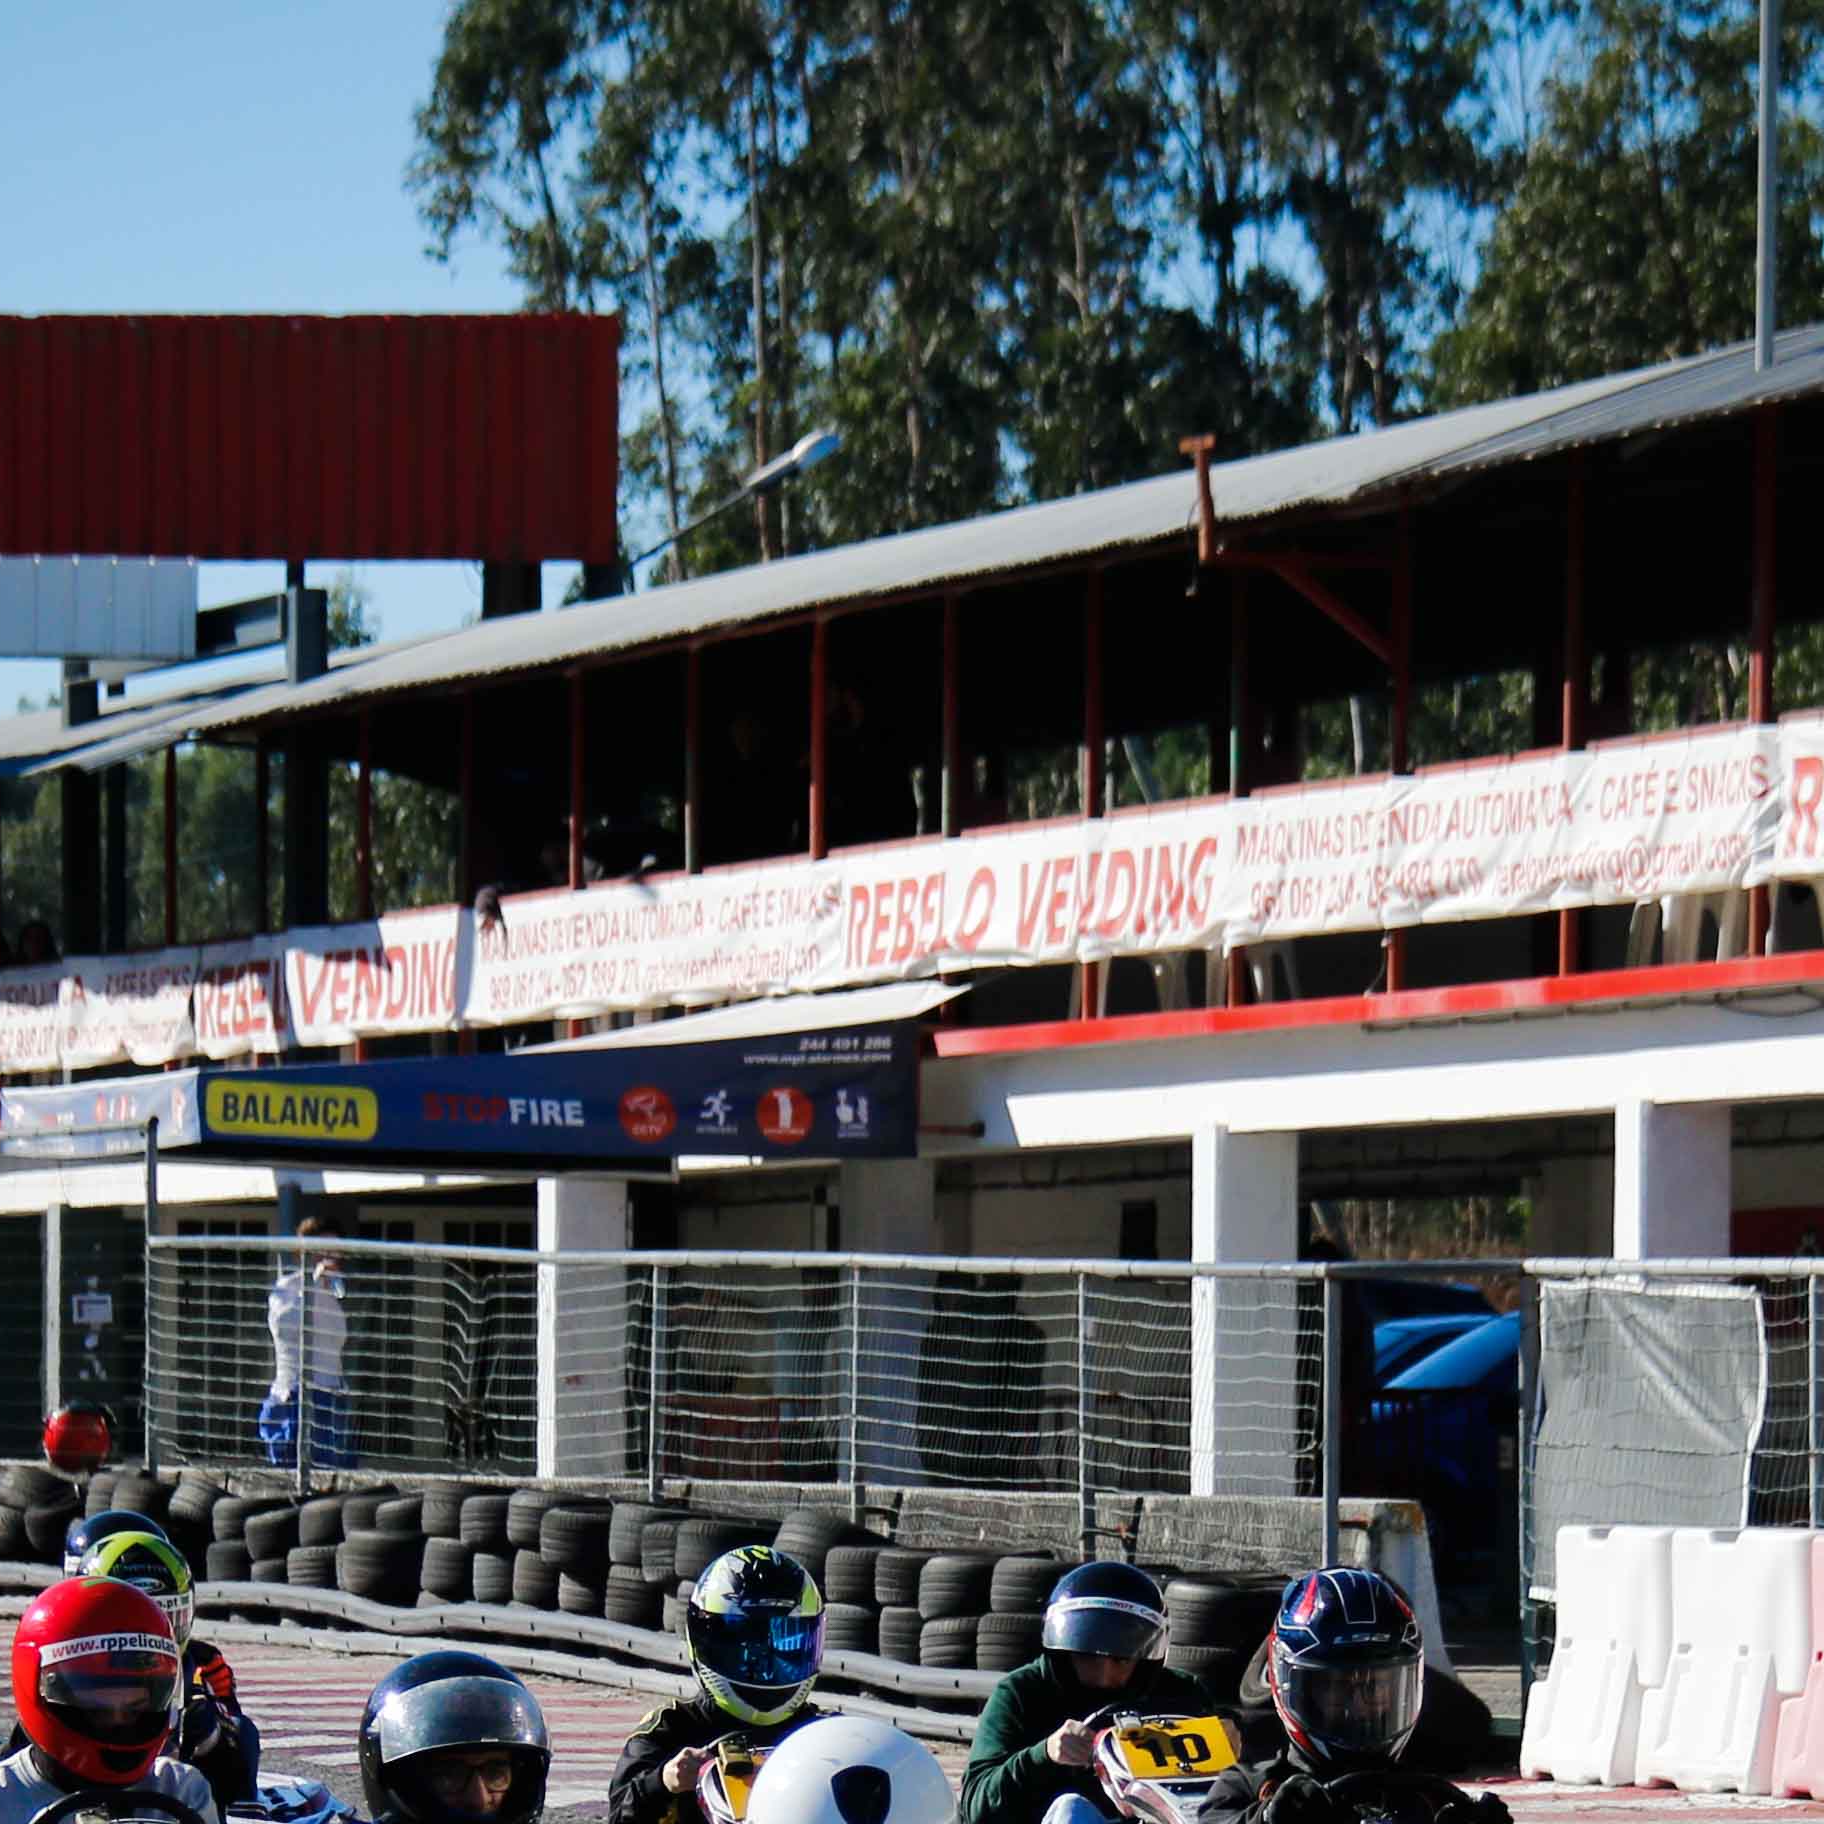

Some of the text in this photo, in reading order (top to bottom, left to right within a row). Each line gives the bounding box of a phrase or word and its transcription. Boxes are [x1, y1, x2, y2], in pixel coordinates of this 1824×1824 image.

[1599, 760, 1659, 822] CAFÉ
[1687, 754, 1771, 813] SNACKS
[843, 837, 1218, 970] REBELO VENDING
[221, 1091, 360, 1133] BALANÇA
[1133, 1732, 1212, 1768] 10
